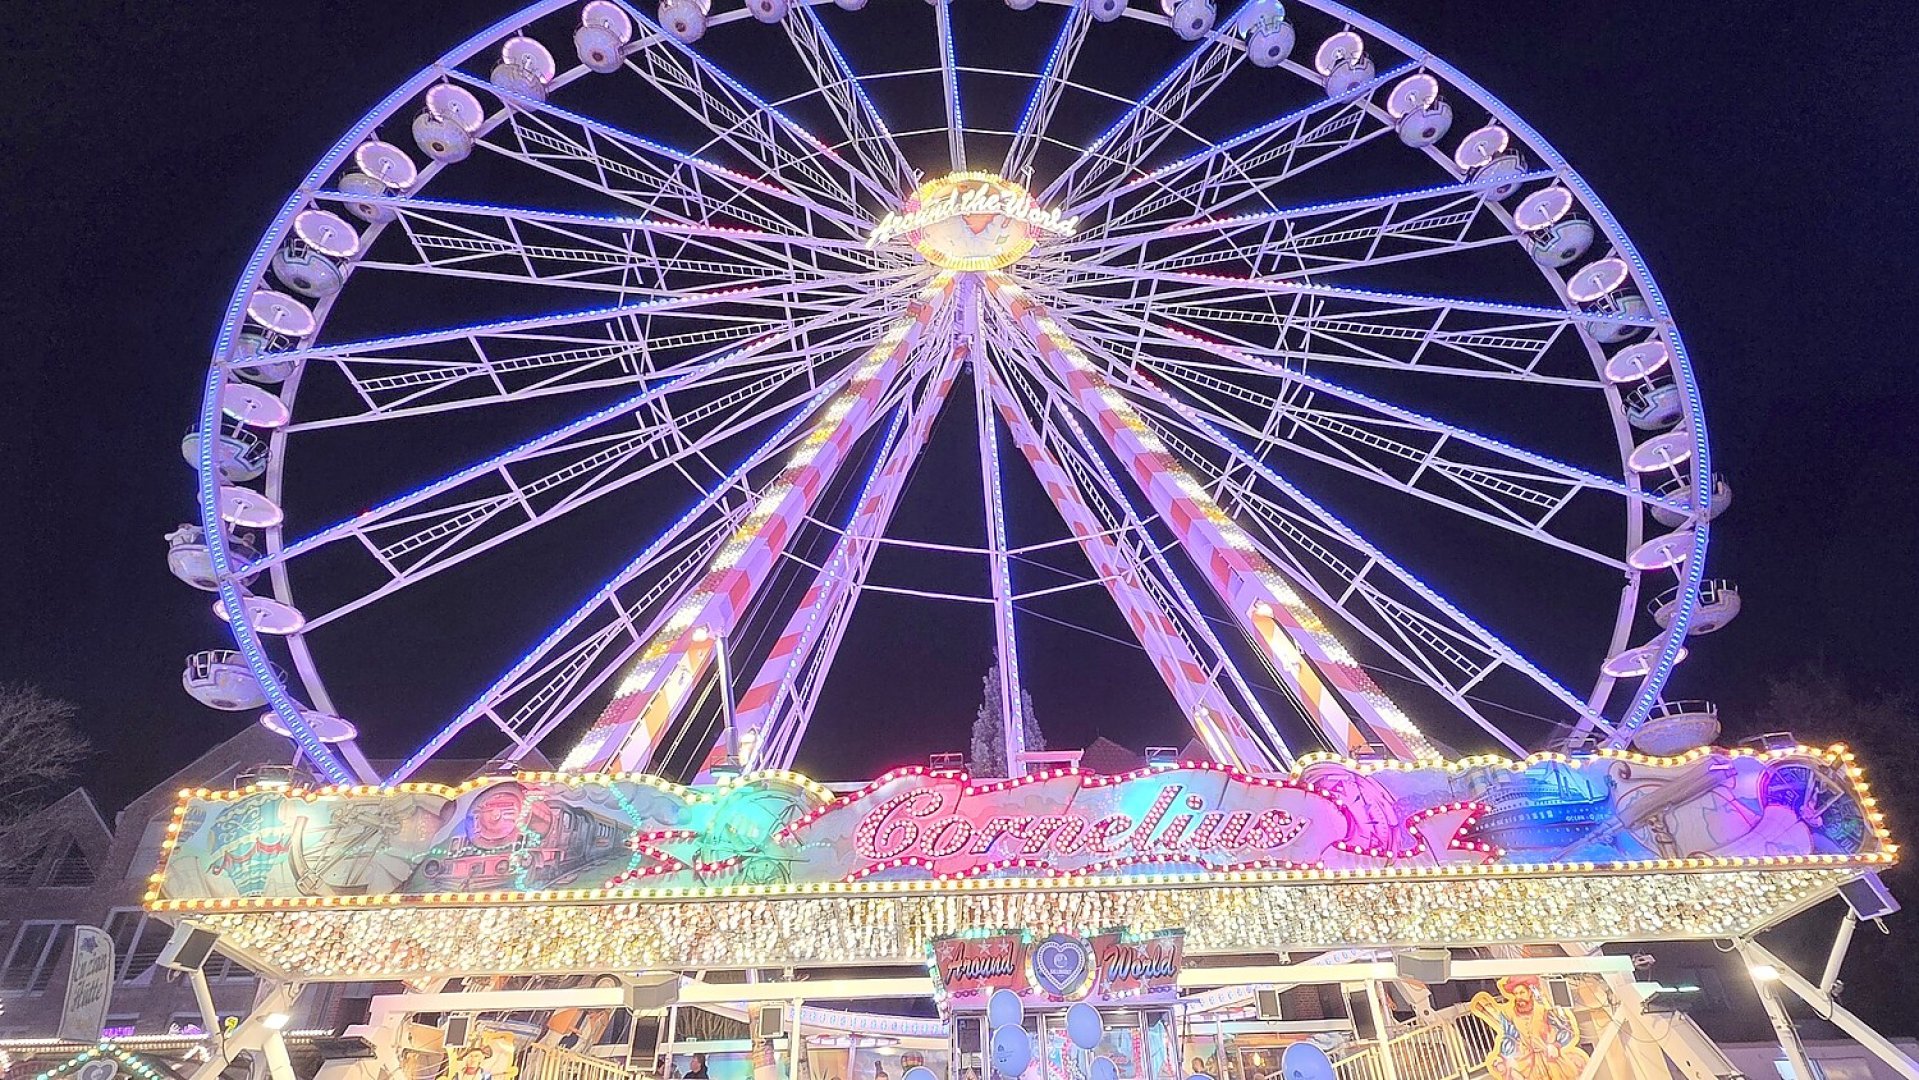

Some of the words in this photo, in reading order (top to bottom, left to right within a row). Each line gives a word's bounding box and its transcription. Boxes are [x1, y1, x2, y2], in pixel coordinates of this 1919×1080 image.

[865, 189, 958, 248] Around
[960, 183, 1001, 213] the
[1002, 190, 1079, 237] World
[854, 783, 1310, 860] Cornelius
[945, 940, 1015, 985] Around
[1104, 942, 1177, 983] World
